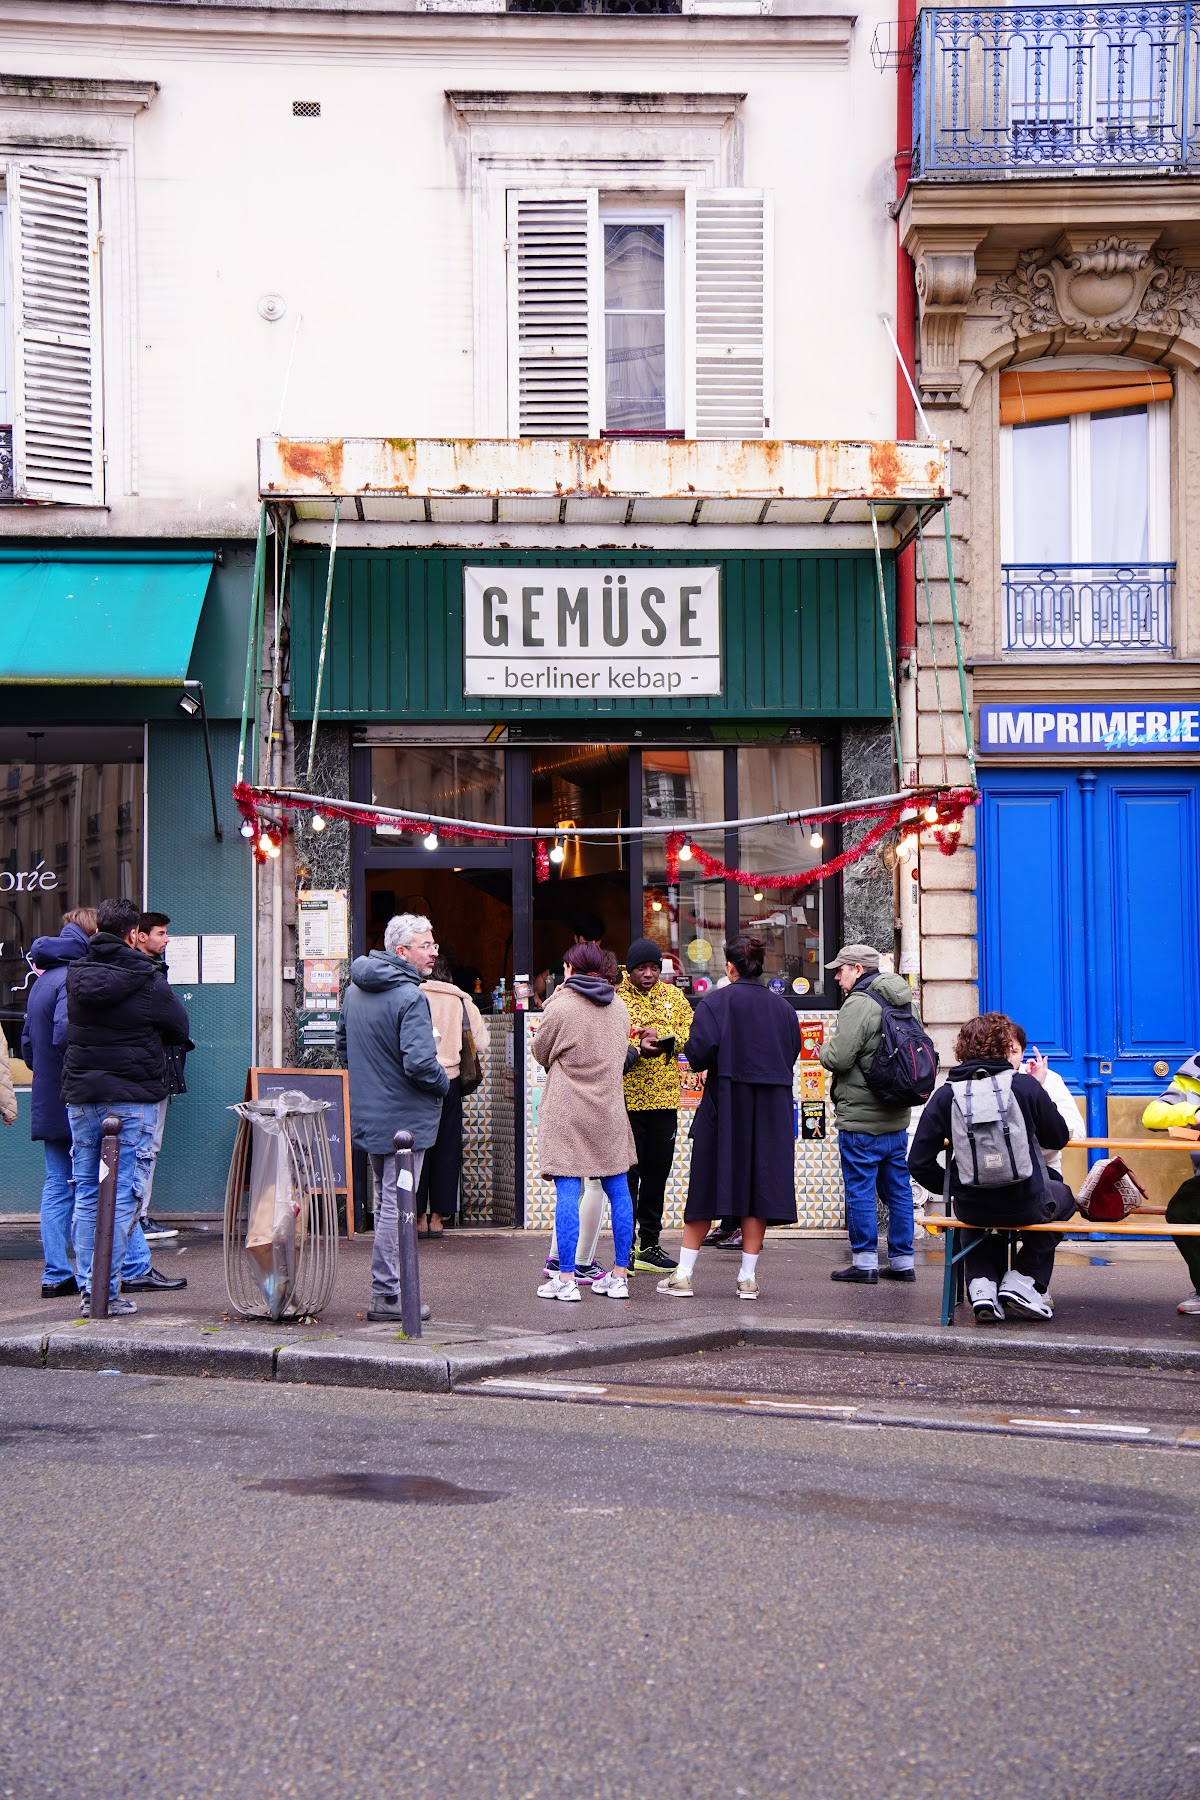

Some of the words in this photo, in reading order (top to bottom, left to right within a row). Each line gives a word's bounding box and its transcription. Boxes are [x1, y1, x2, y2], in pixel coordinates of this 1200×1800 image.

[482, 575, 702, 647] GEMÜSE
[504, 666, 600, 689] berliner
[608, 666, 682, 693] kebap
[987, 711, 1199, 744] IMPRIMERIE
